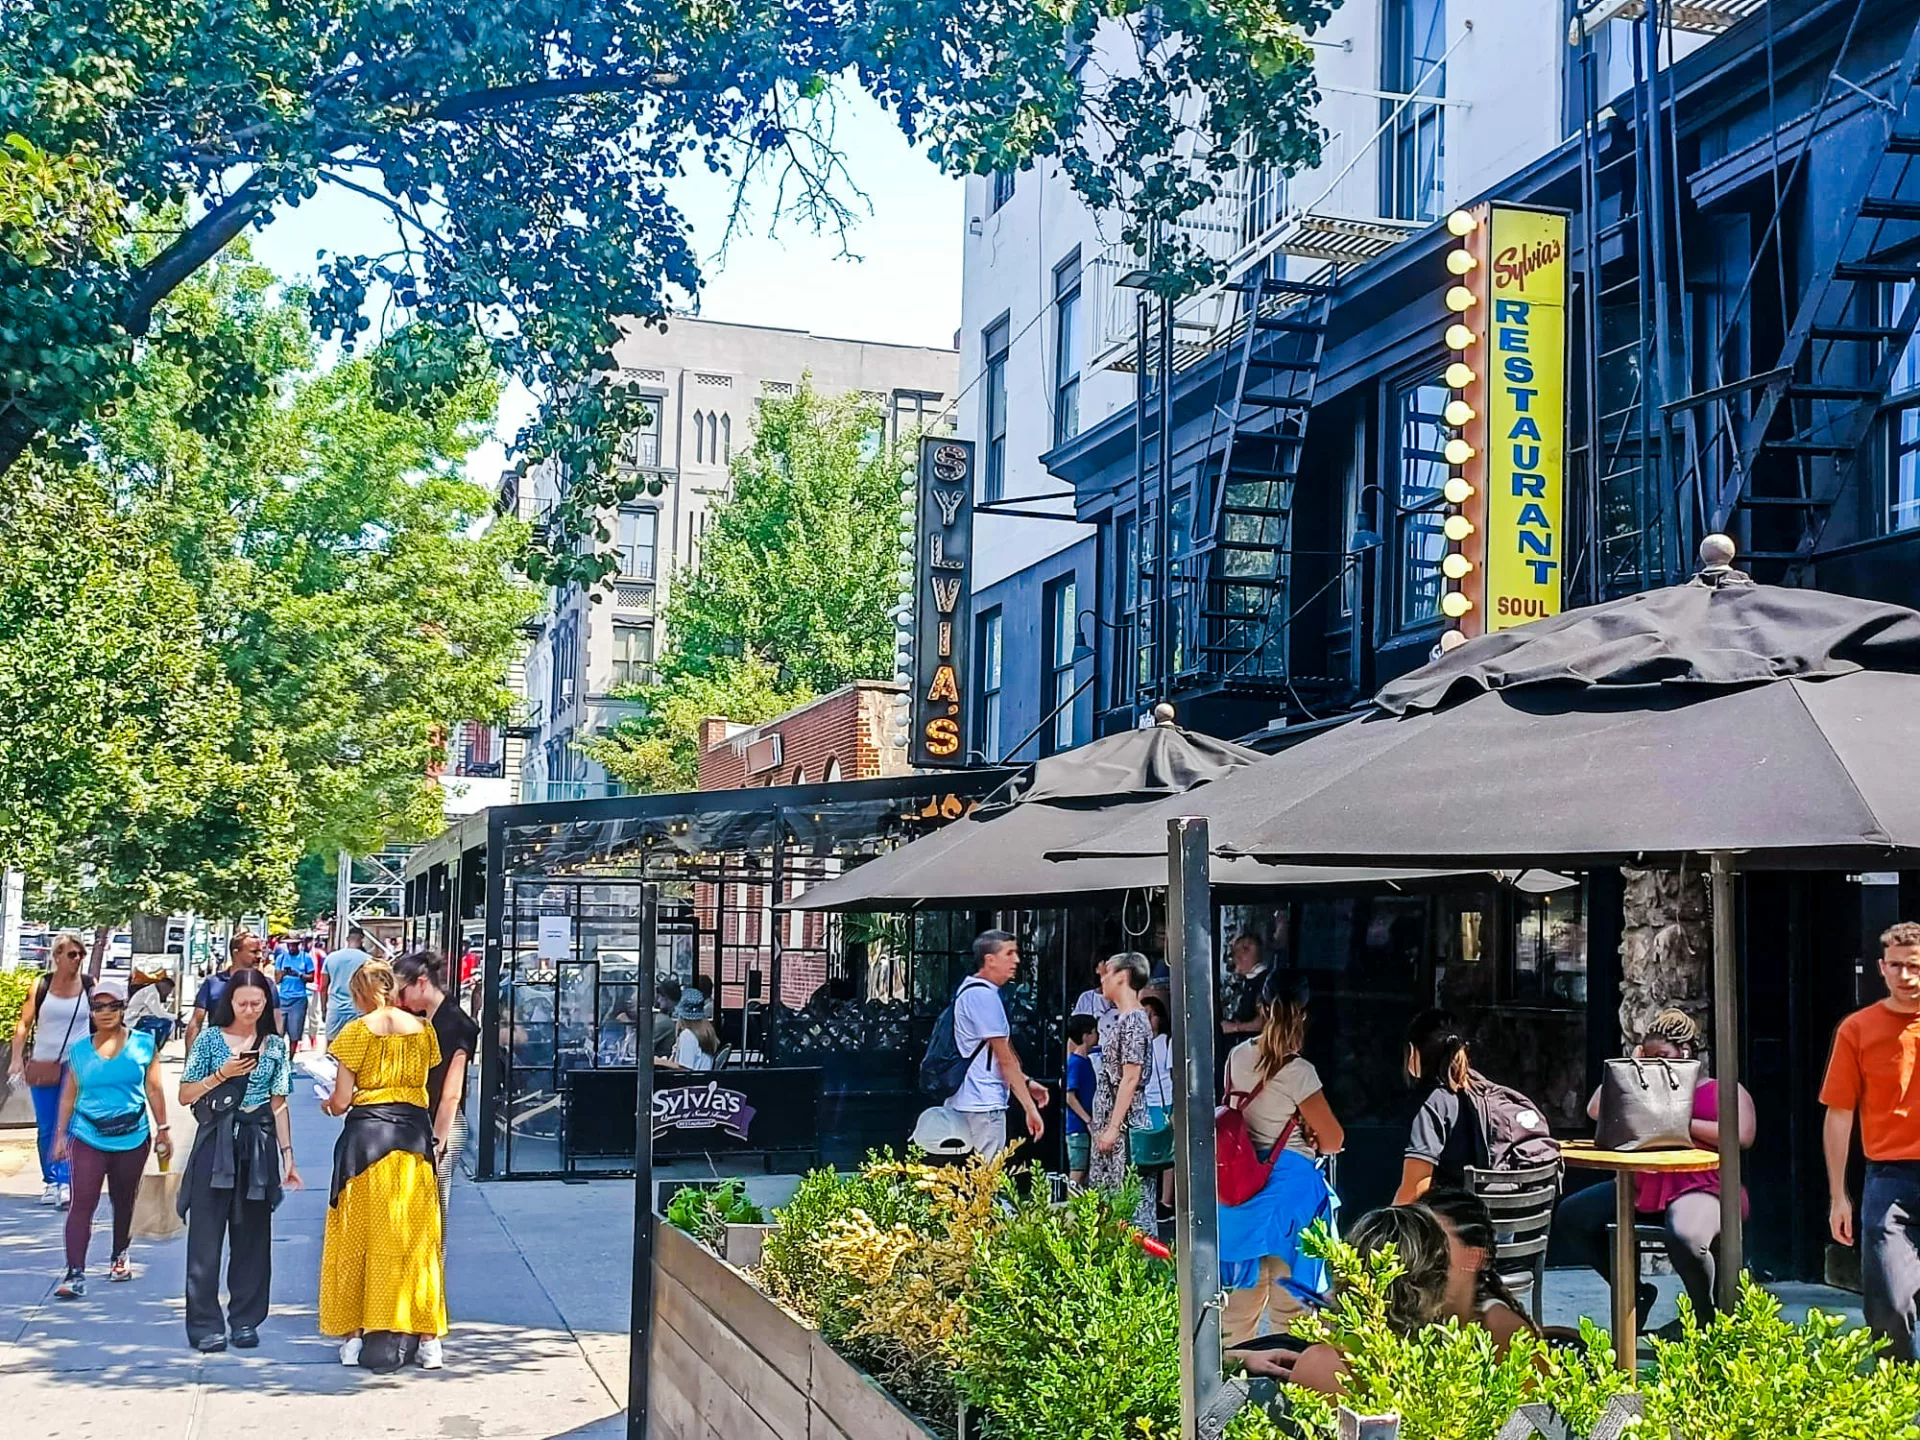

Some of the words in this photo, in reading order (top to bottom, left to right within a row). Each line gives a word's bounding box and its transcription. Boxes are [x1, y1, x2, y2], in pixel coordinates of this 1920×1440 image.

[1494, 239, 1561, 292] Sylvia's
[1495, 299, 1557, 585] RESTAURANT
[925, 445, 967, 756] SYLVIA'S
[1497, 596, 1550, 618] SOUL
[652, 1080, 741, 1117] Sylvia's
